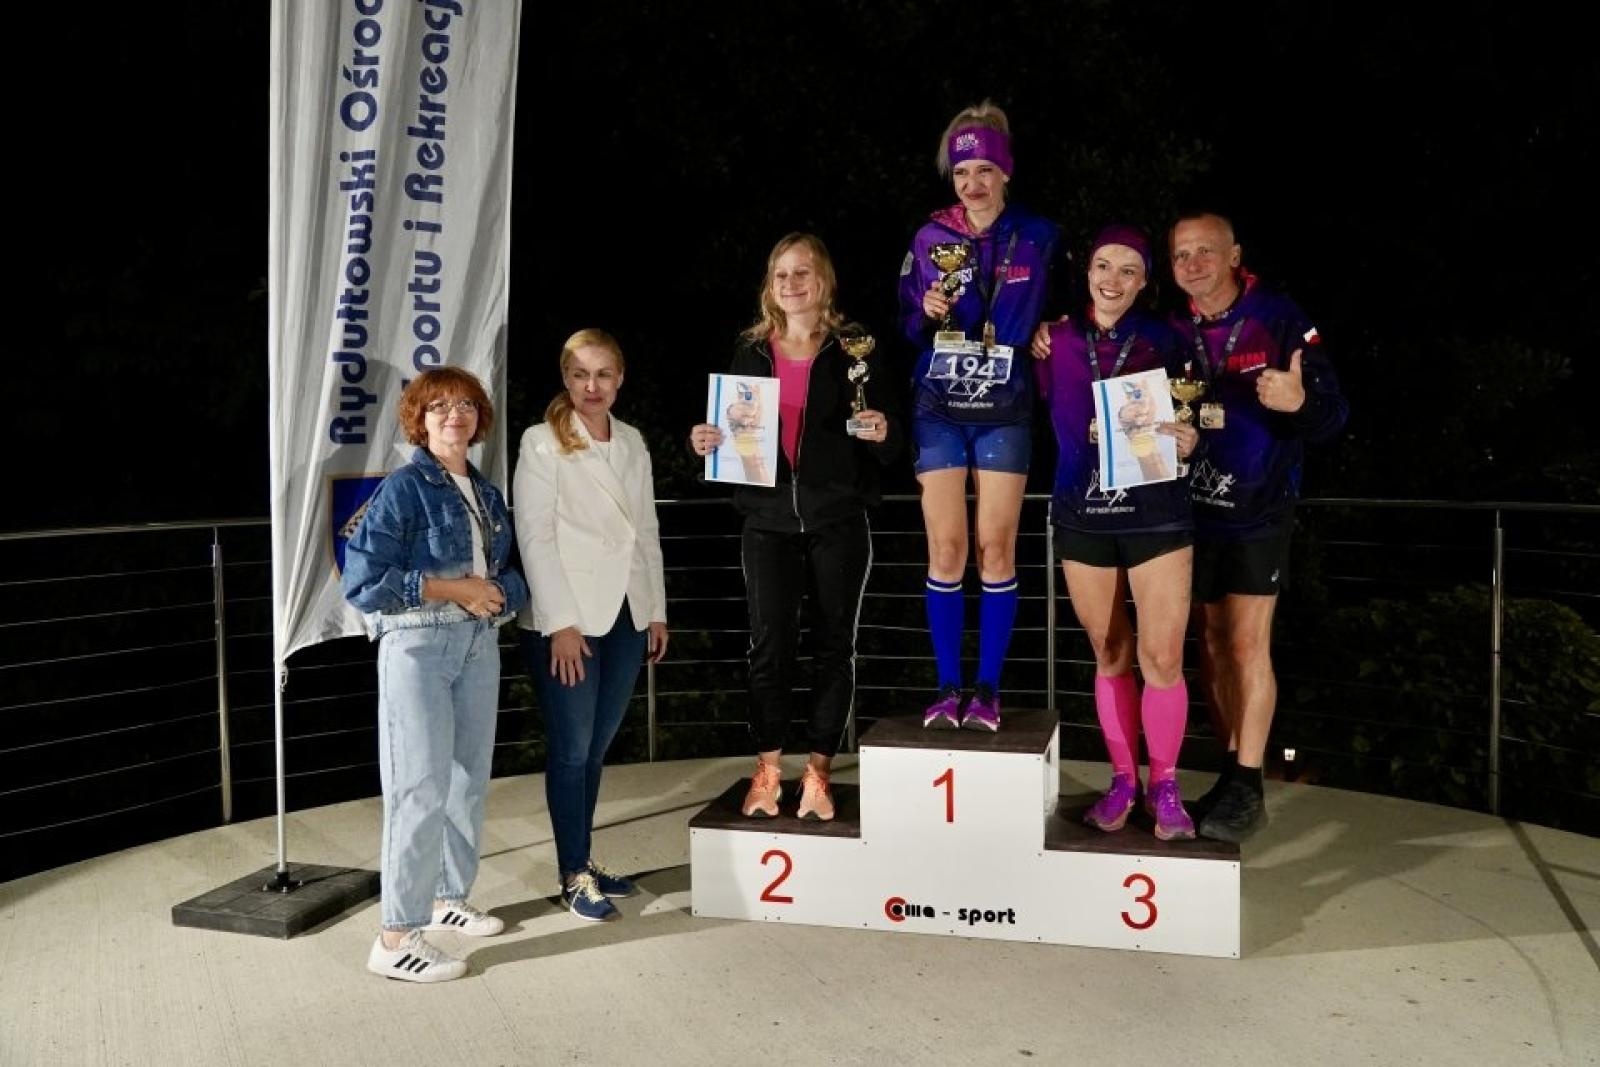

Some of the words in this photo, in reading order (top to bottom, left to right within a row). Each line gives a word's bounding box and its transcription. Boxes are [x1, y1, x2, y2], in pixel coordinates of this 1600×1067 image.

[403, 219, 442, 233] i
[330, 150, 377, 444] Rydułtowski
[401, 251, 442, 391] portu
[946, 354, 996, 381] 194
[934, 769, 954, 822] 1
[760, 849, 792, 904] 2
[1122, 873, 1157, 929] 3
[957, 908, 1016, 926] sport
